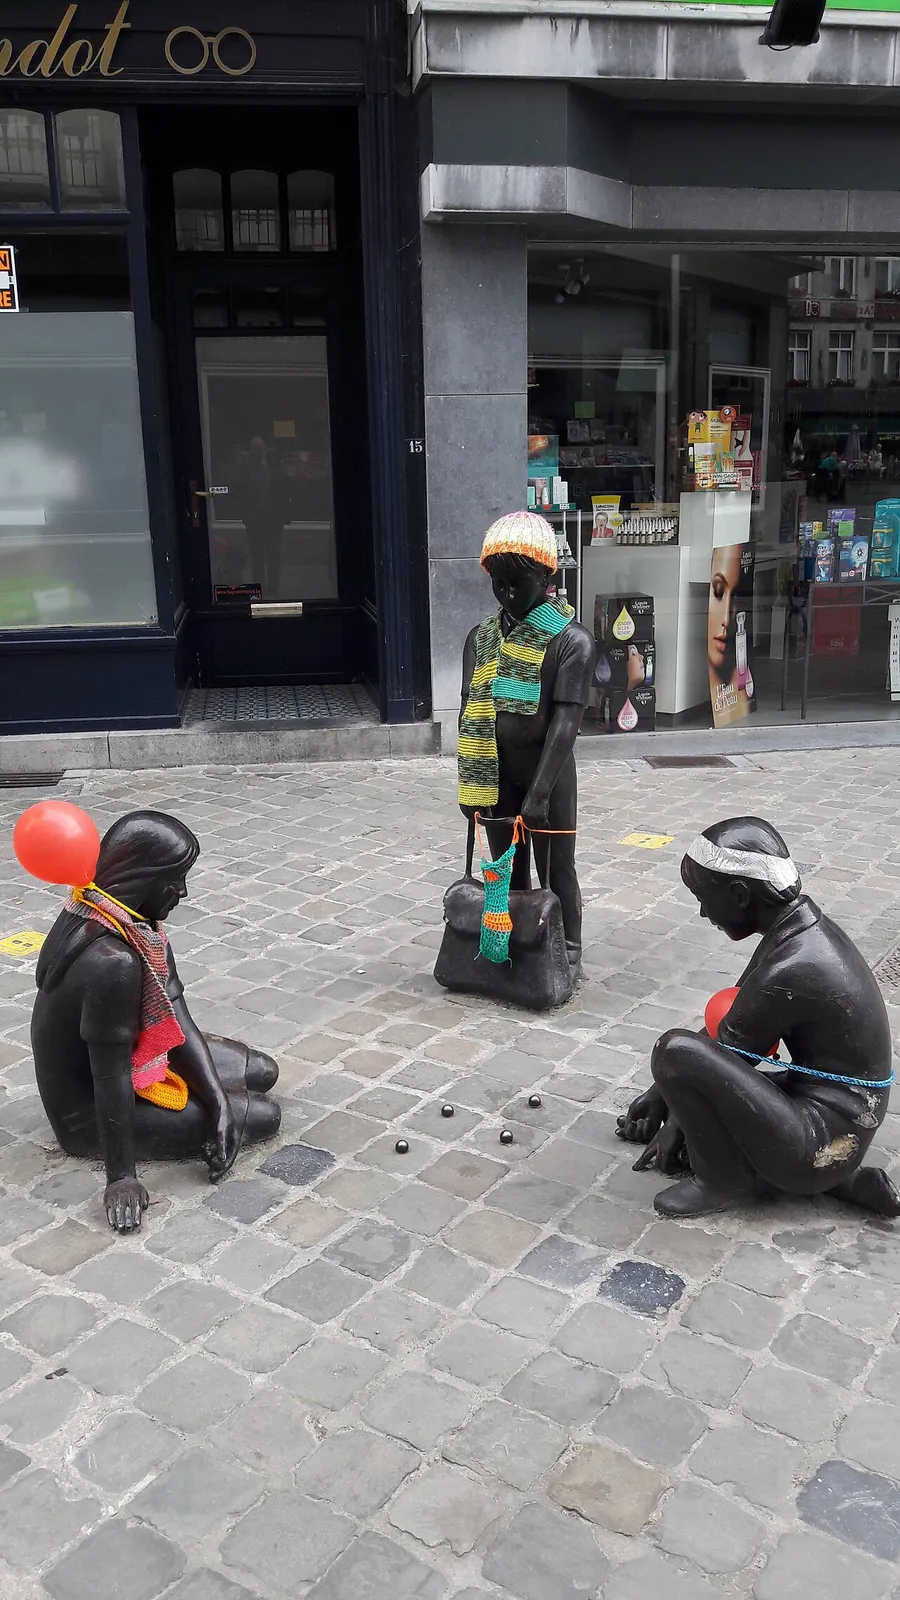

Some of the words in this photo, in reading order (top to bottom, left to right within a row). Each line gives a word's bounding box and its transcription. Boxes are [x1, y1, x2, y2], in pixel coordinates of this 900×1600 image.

[409, 440, 423, 453] 15
[716, 683, 734, 698] L'Eau
[714, 698, 722, 712] de
[722, 694, 738, 708] Peau
